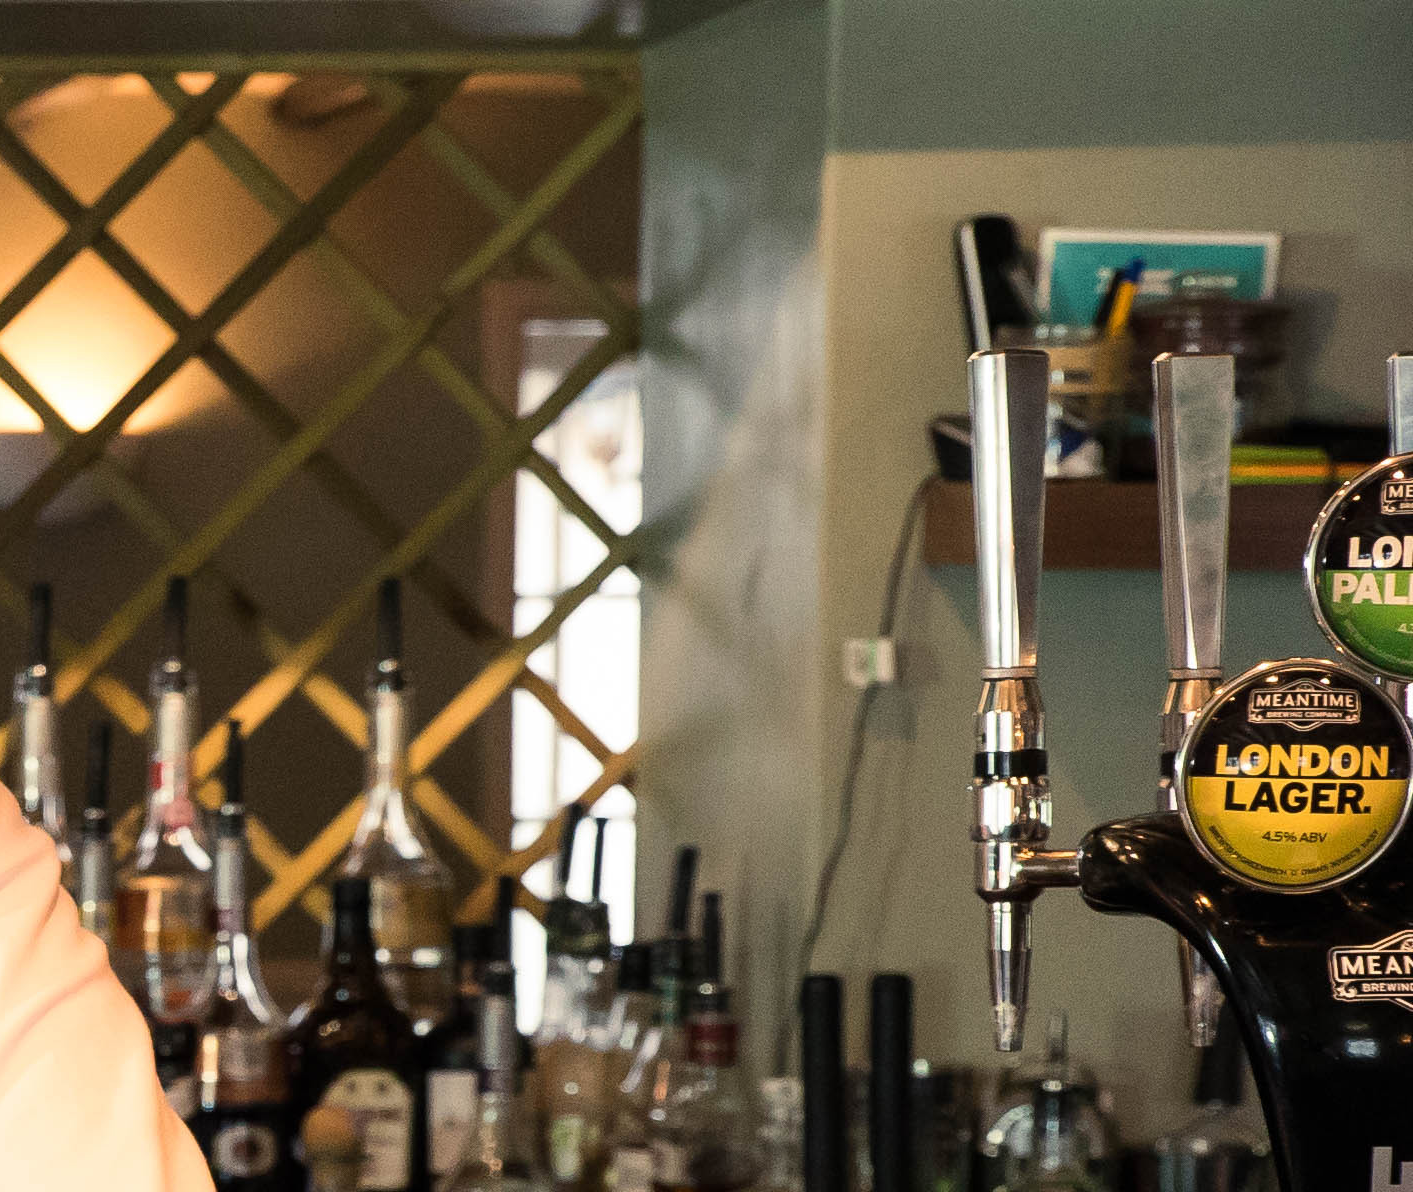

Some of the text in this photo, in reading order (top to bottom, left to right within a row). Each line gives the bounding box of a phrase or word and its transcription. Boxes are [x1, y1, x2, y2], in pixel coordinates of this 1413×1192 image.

[1333, 572, 1413, 606] PAL
[1255, 692, 1355, 708] MEANTIME
[1215, 743, 1389, 778] LONDON
[1224, 780, 1372, 815] LAGER.
[1299, 832, 1328, 843] ABV
